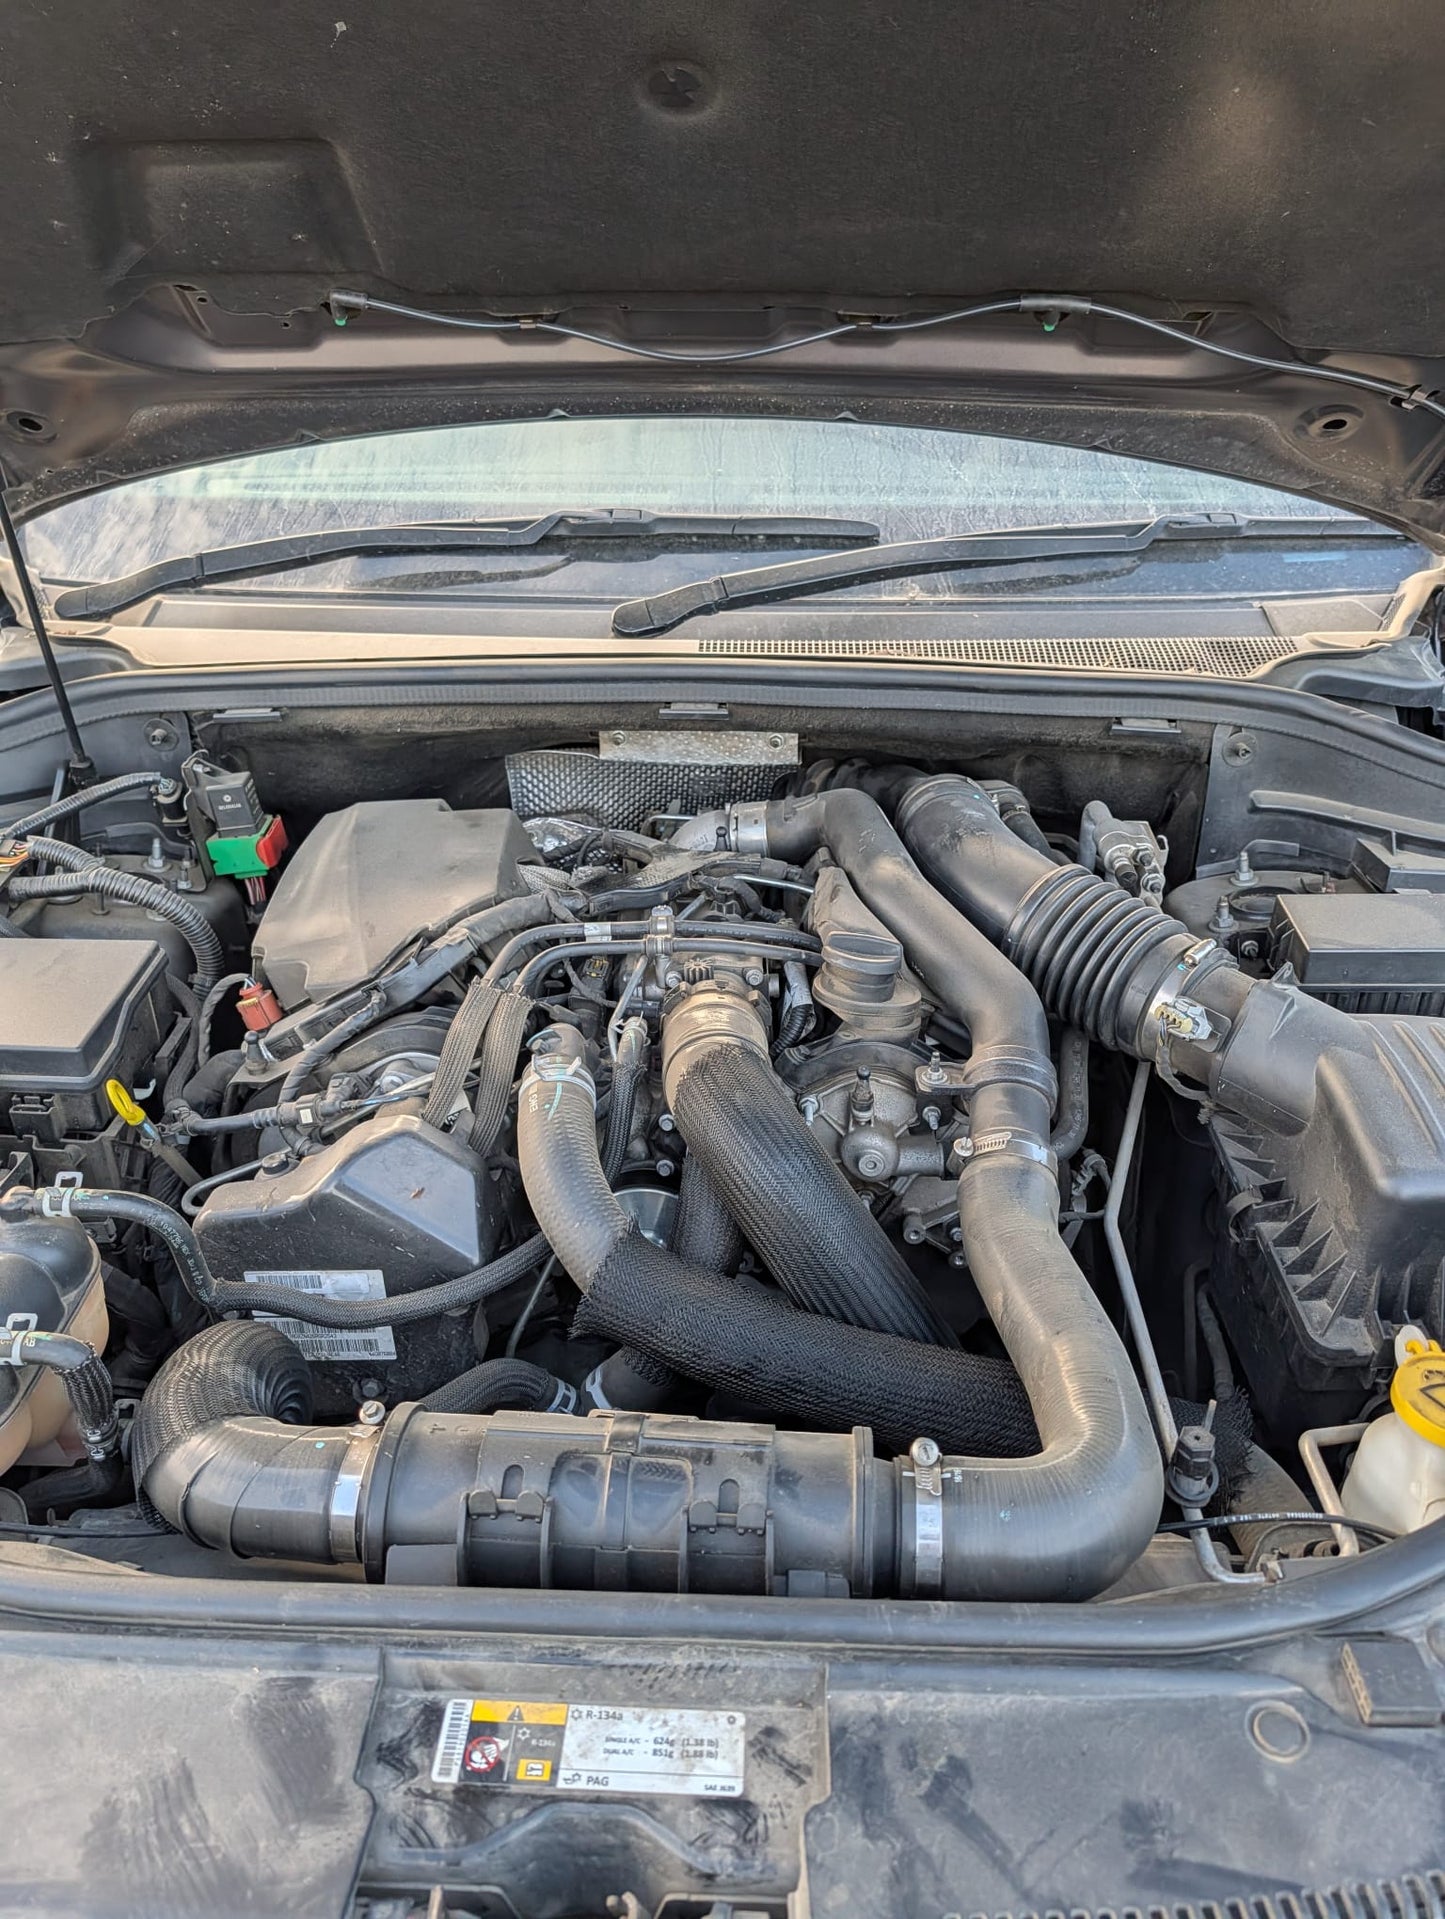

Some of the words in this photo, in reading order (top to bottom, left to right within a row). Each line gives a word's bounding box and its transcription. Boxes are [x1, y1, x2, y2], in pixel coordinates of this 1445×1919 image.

[586, 1709, 623, 1721] R-134a
[653, 1737, 675, 1747] 624g
[682, 1738, 705, 1748] (1.38
[707, 1739, 719, 1748] lb)
[652, 1749, 674, 1759] 851g
[681, 1749, 704, 1759] (1.88
[706, 1750, 718, 1760] lb)
[586, 1776, 610, 1787] PAG
[704, 1783, 717, 1791] SAE
